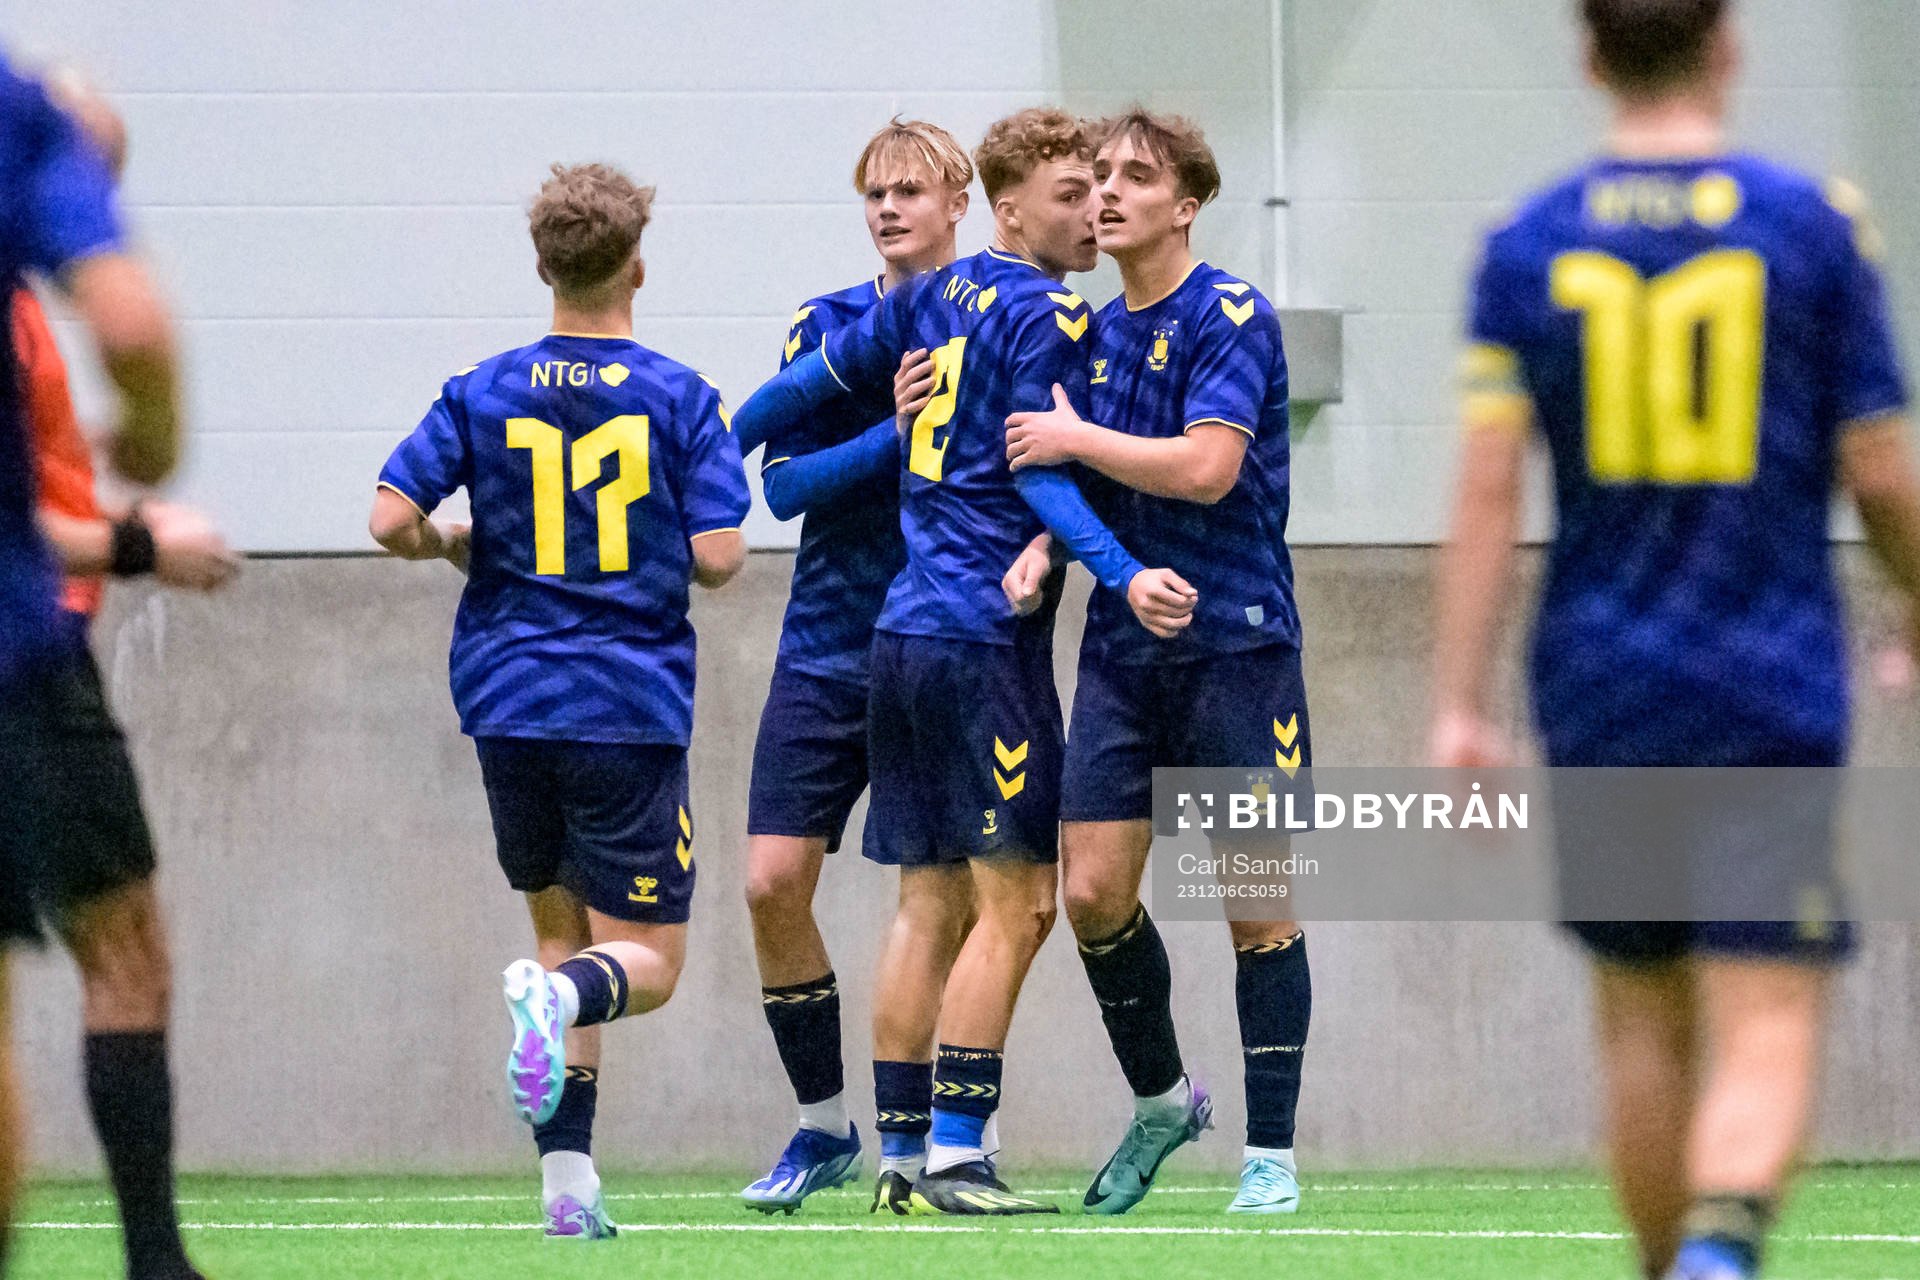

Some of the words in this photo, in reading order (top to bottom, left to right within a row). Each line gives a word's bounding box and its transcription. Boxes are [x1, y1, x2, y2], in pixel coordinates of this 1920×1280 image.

[531, 361, 588, 387] NTG
[909, 336, 968, 482] 2
[1551, 250, 1766, 483] 10
